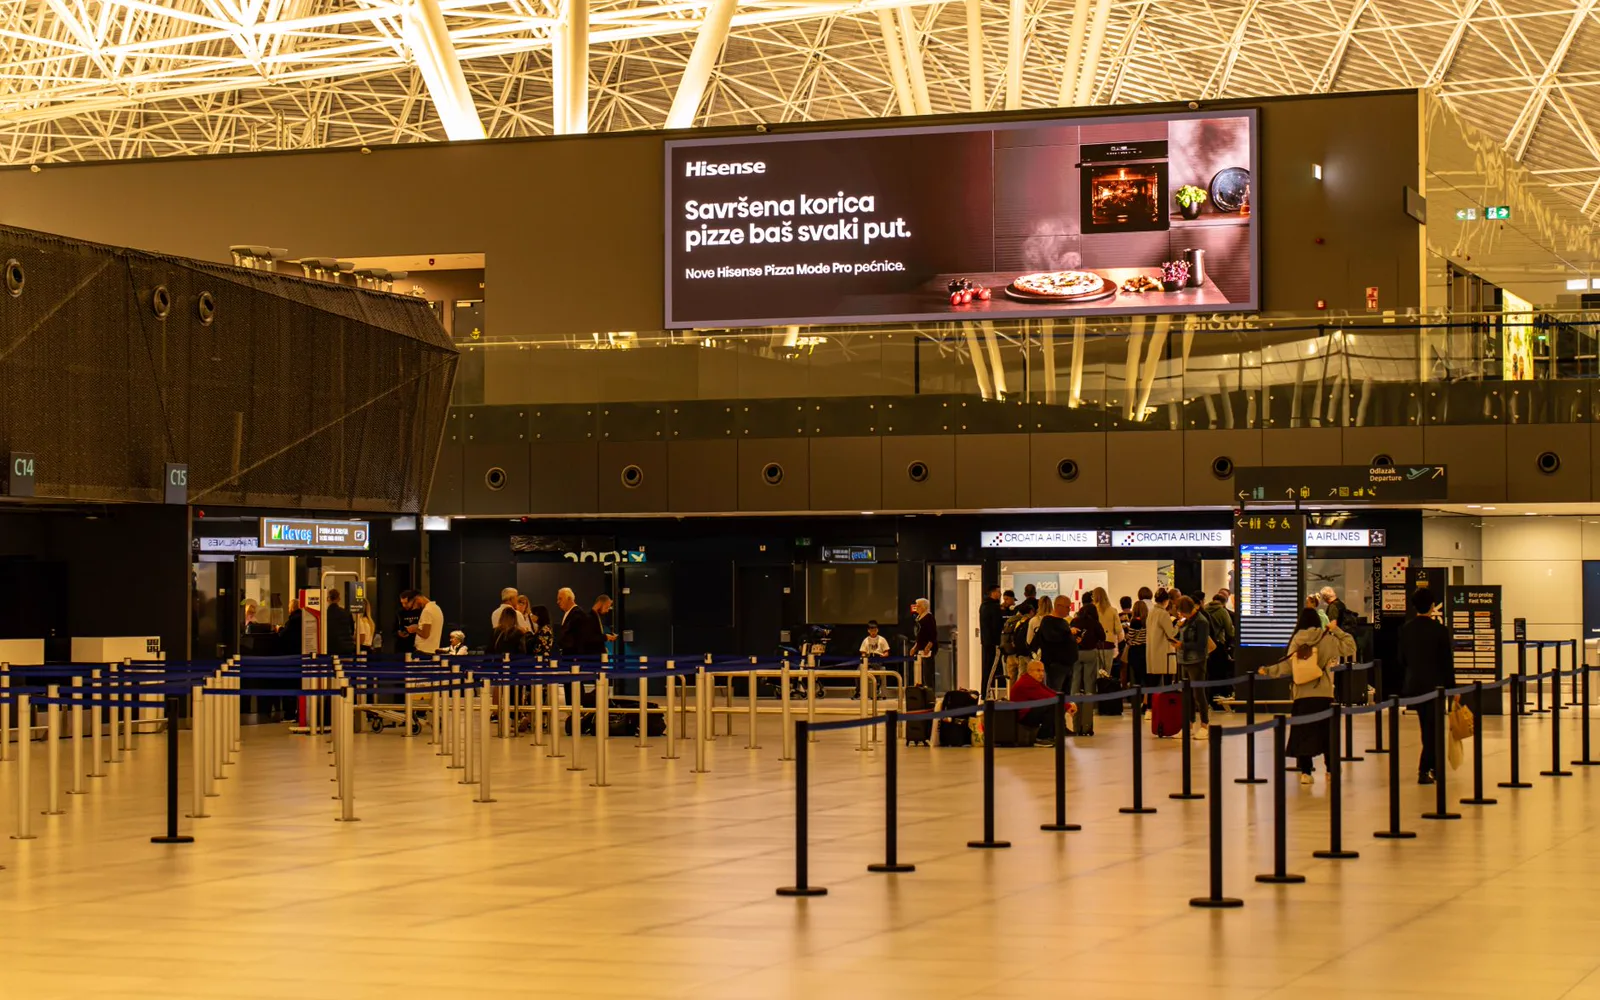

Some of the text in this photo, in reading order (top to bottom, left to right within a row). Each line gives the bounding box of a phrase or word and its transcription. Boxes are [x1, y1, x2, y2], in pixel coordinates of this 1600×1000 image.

[685, 160, 766, 177] Hisense
[685, 191, 875, 220] Savršena korica
[685, 217, 912, 252] pizze baš svaki put.
[685, 260, 906, 279] Nove Hisense Pizza Mode Pro pećnice.
[14, 458, 35, 476] C14
[1369, 467, 1396, 475] Odlazak
[170, 469, 187, 486] C15
[1004, 532, 1088, 543] CROATIA AIRLINES
[1136, 531, 1222, 542] CROATIA AIRLINES
[1316, 531, 1360, 541] AIRLINES
[1036, 581, 1058, 591] A220
